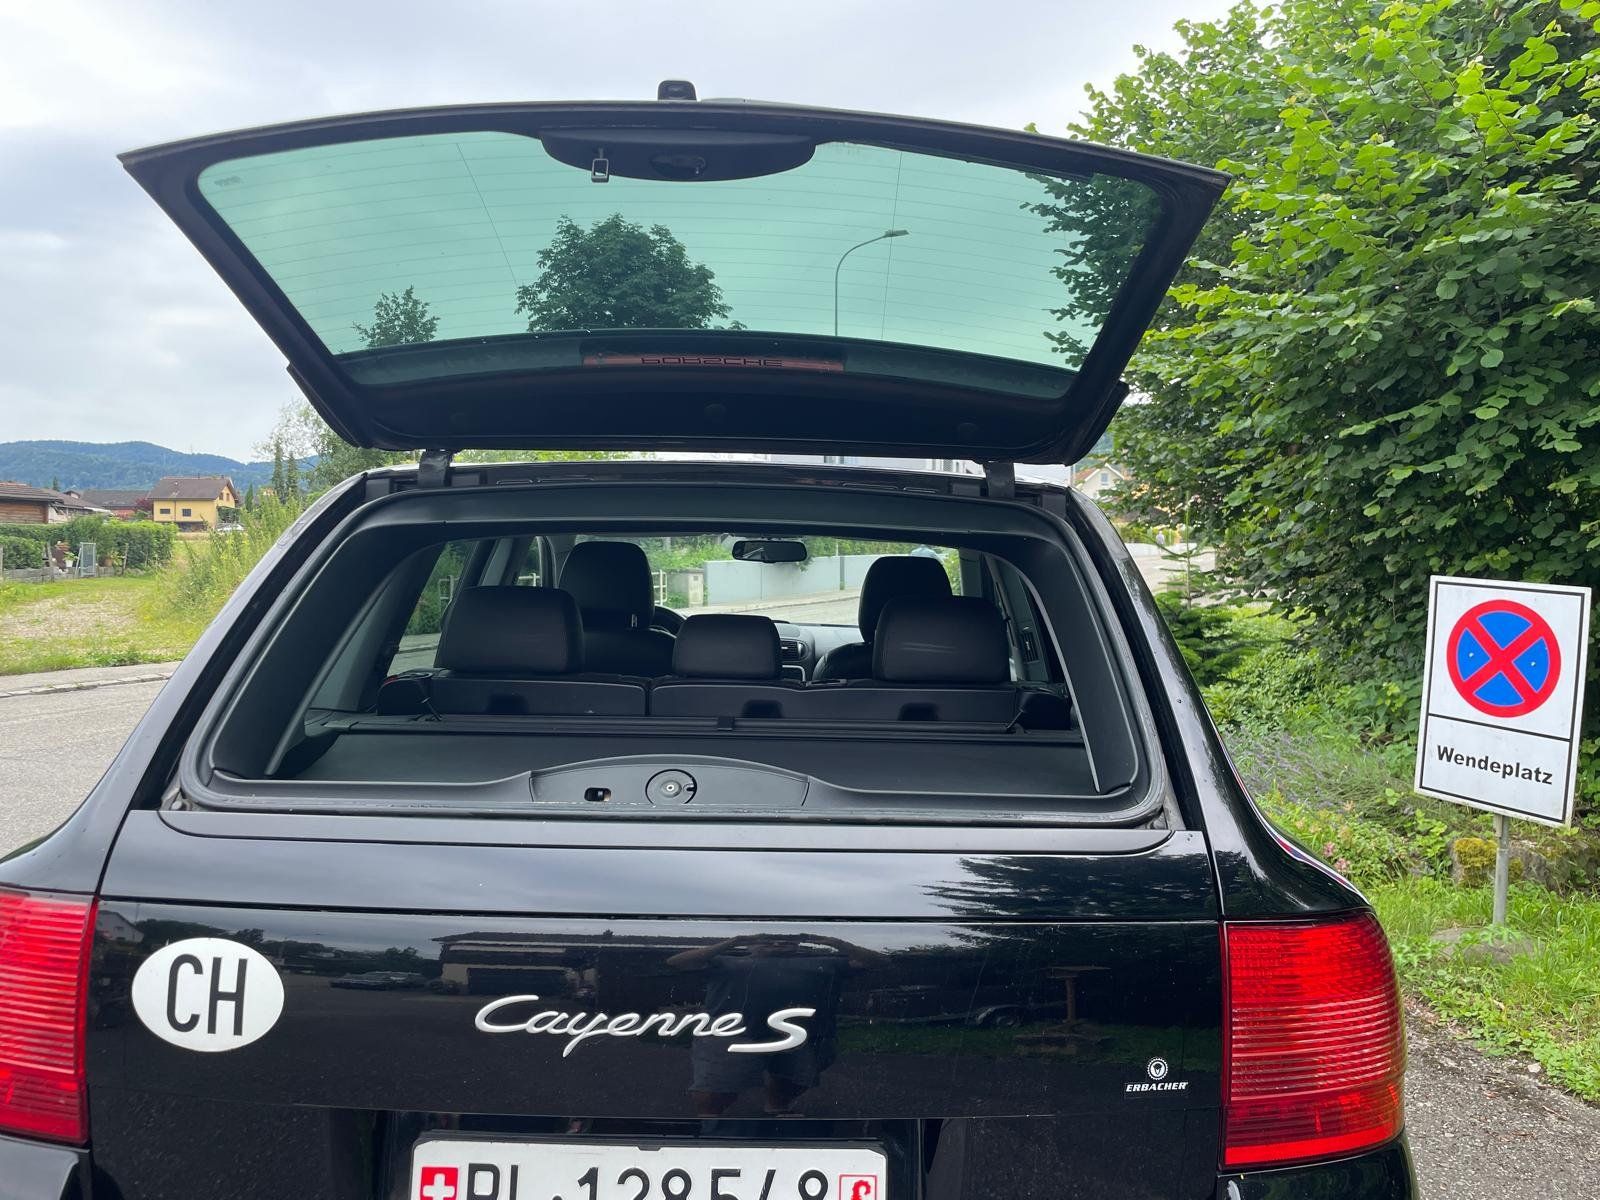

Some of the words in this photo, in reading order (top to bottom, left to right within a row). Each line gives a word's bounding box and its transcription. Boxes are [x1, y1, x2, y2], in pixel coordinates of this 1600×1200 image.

[1436, 744, 1553, 785] Wendeplatz
[166, 953, 248, 1036] CH
[474, 994, 747, 1058] Cayenne
[727, 1007, 817, 1053] S
[1125, 1081, 1187, 1093] ERBACHER
